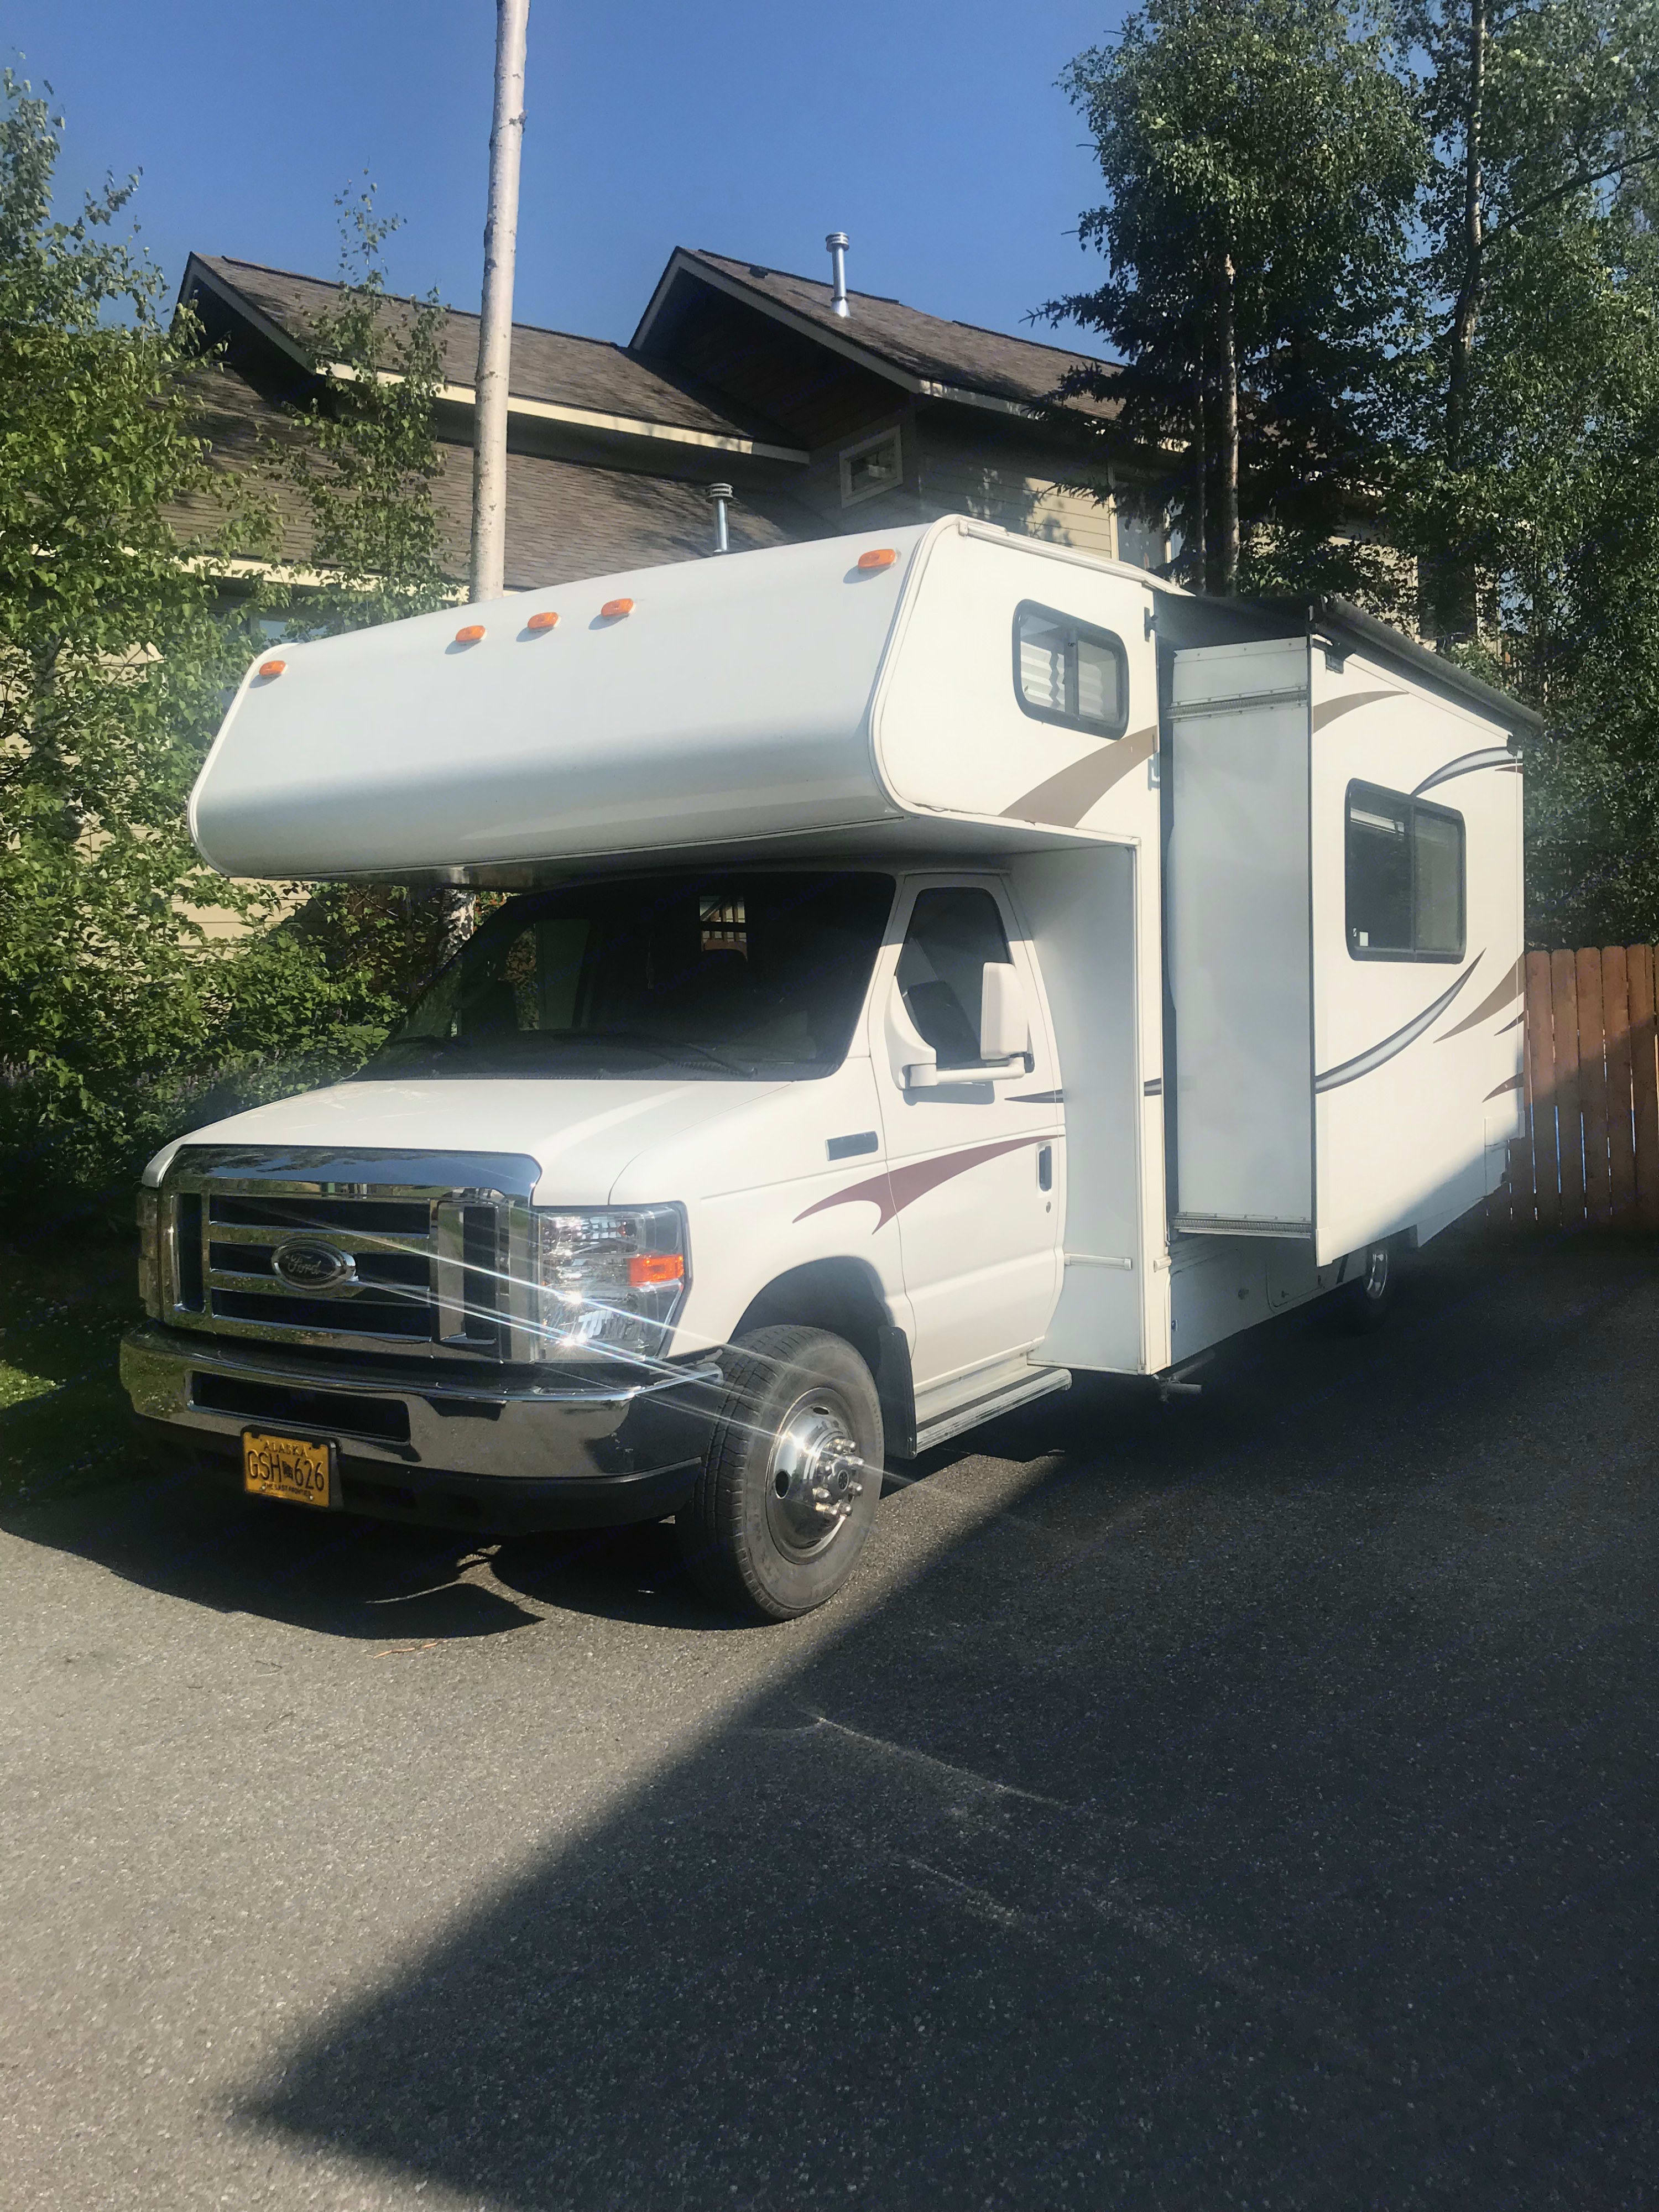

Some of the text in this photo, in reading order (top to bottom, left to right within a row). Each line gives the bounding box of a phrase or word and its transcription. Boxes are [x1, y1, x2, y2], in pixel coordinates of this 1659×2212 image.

[285, 1253, 321, 1276] Ford
[264, 1440, 309, 1457] ALASKA
[248, 1449, 325, 1491] GSH 626
